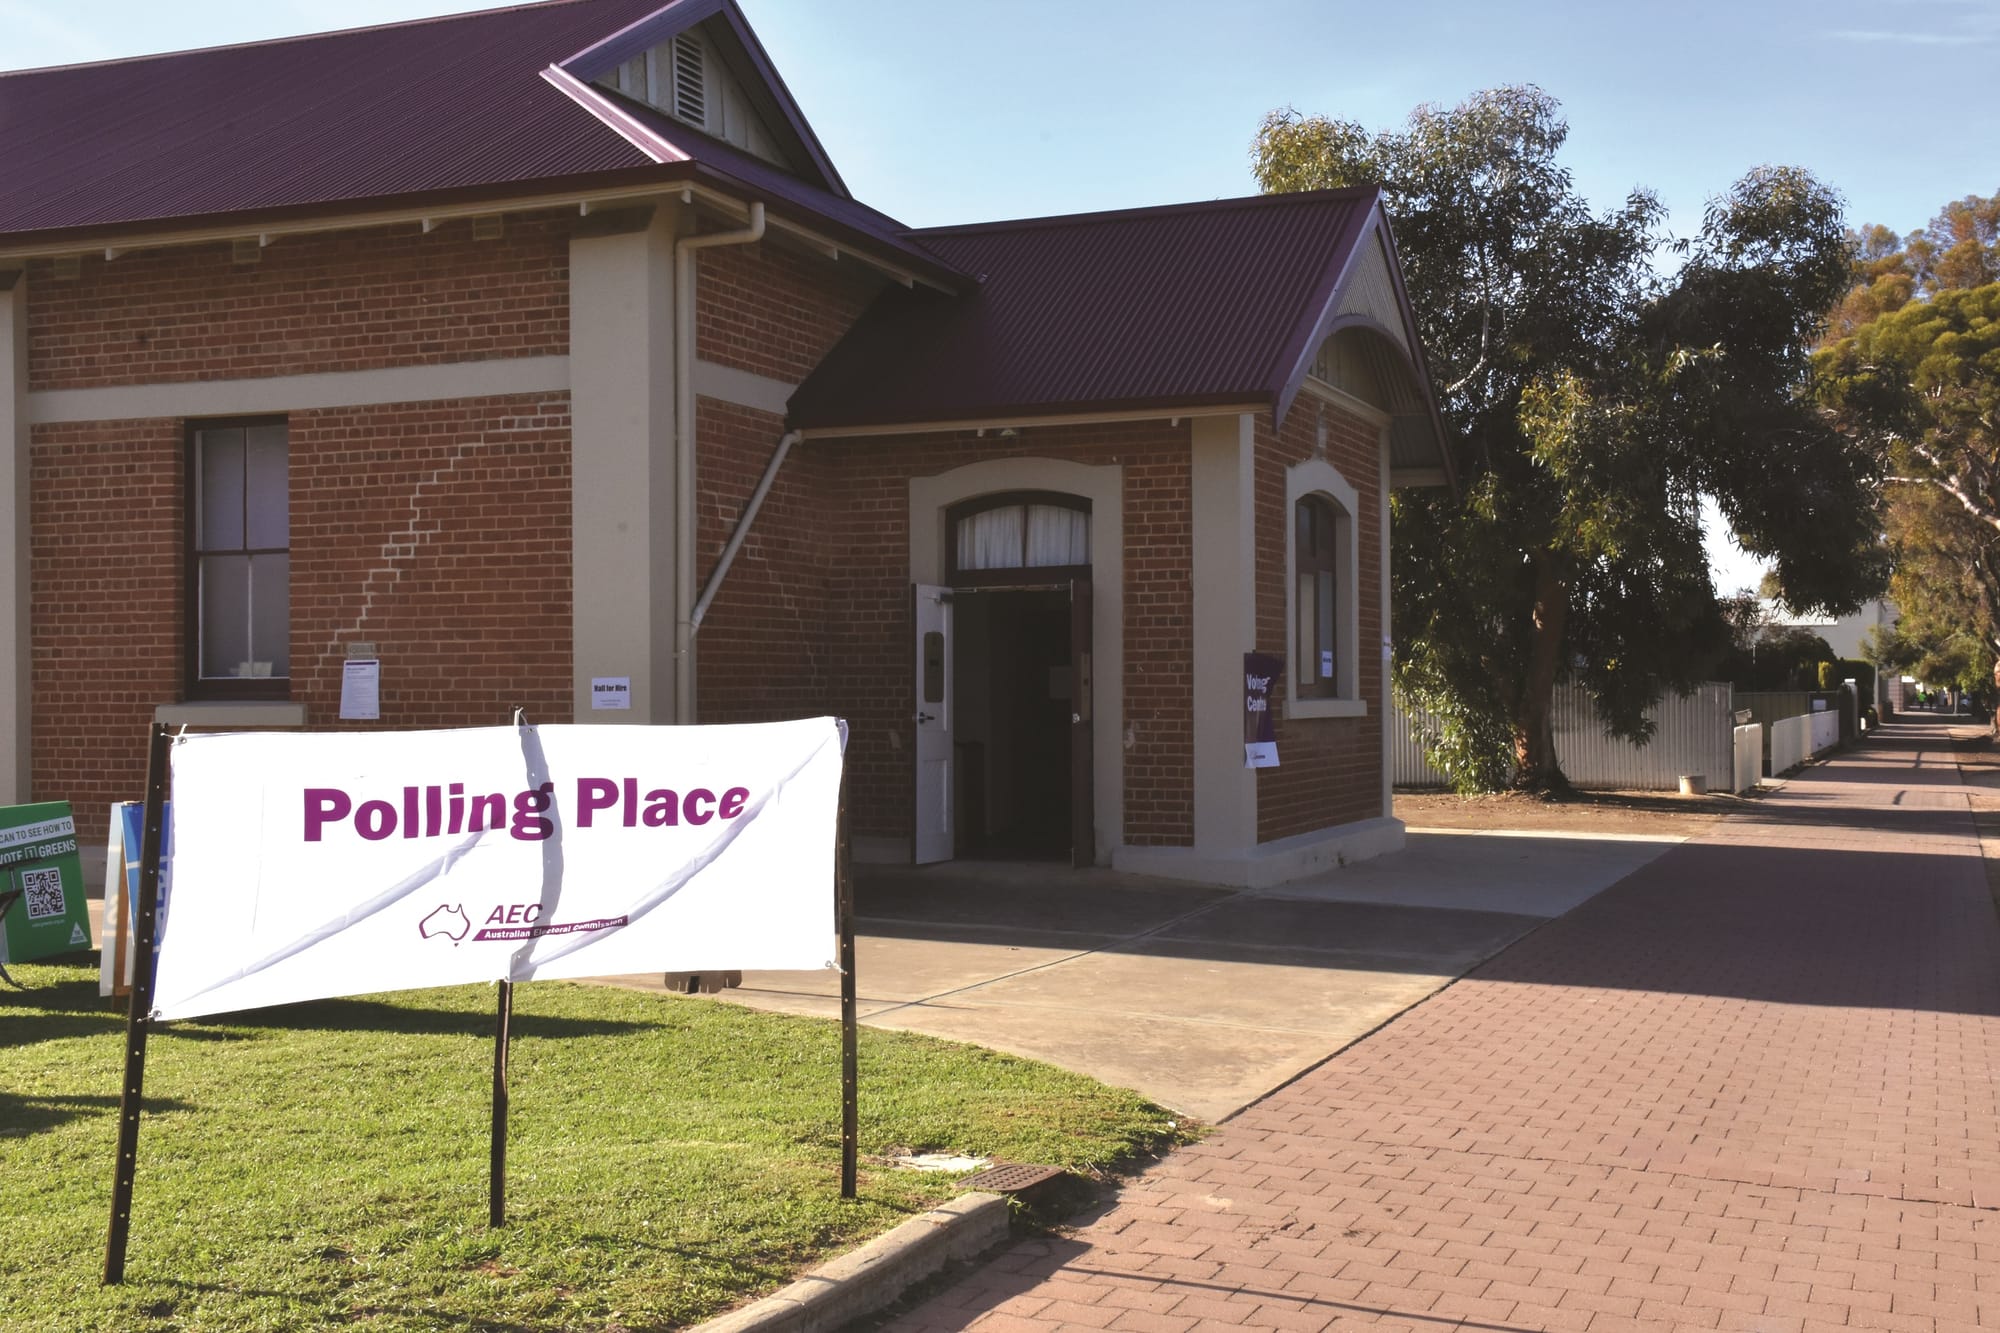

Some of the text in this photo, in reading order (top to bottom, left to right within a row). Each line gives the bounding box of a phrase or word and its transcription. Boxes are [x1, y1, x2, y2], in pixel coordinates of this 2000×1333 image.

[304, 777, 750, 842] Polling Place
[16, 830, 27, 840] TO
[27, 827, 42, 838] SEE
[43, 823, 60, 835] HOW
[61, 820, 72, 831] TO
[38, 839, 77, 857] GREENS
[485, 903, 543, 925] AEC
[484, 930, 531, 939] Australian
[533, 926, 571, 937] Electoral
